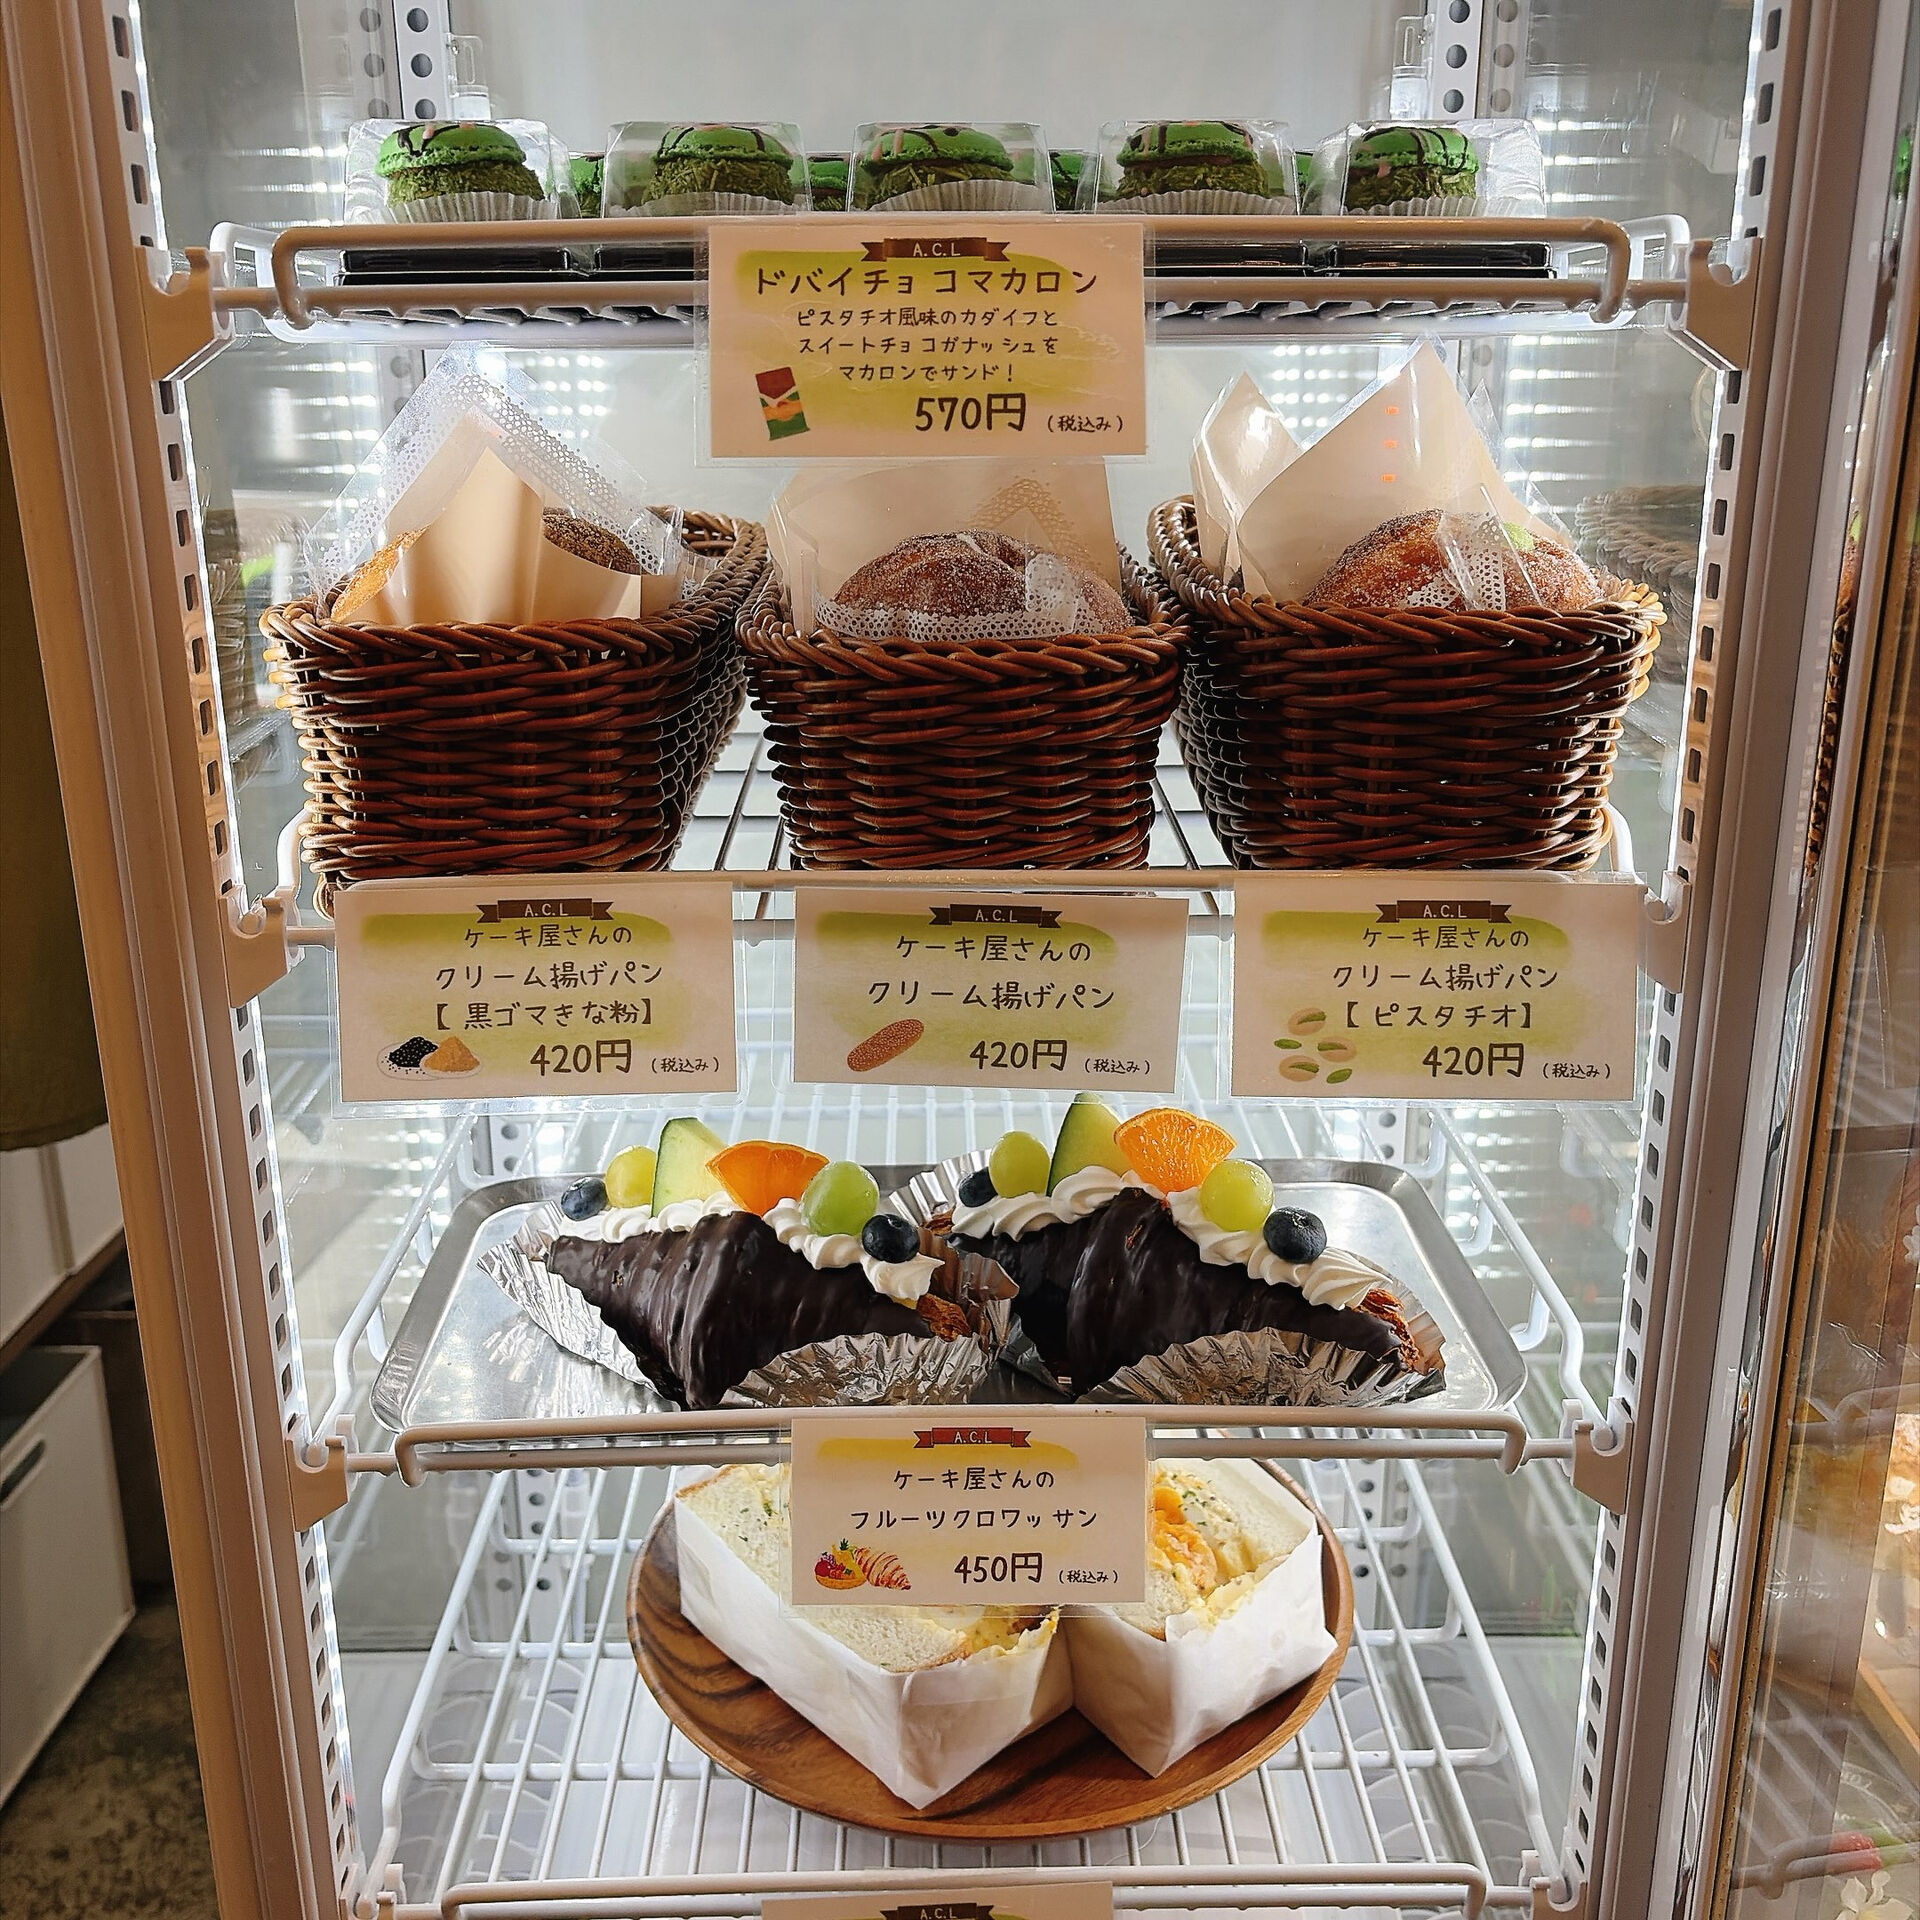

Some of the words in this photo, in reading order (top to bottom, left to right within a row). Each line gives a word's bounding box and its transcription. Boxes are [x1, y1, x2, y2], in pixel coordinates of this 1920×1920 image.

[913, 243, 961, 257] A.C.L
[756, 267, 1097, 296] ドバイチョコマカロン
[798, 307, 1058, 327] ピスタチオ風味のカダイフと
[799, 336, 1058, 354] スイートチョコガナッシュを
[915, 393, 1026, 432] 570円
[524, 904, 569, 917] A.C.L
[976, 909, 1018, 922] A.C.L
[1423, 904, 1468, 918] A.C.L
[465, 925, 632, 948] ケーキ屋さんの
[897, 935, 1091, 962] ケーキ屋さんの
[1362, 926, 1529, 949] ケーキ屋さんの
[435, 962, 663, 989] クリーム揚げパン
[1333, 964, 1558, 990] クリーム揚げパン
[868, 982, 1114, 1009] クリーム揚げパン
[437, 999, 652, 1030] 【黒ゴマきな粉】
[1347, 1002, 1531, 1028] 【ピスタチオ】
[530, 1039, 631, 1076] 420円
[970, 1039, 1067, 1070] 420円
[1422, 1043, 1525, 1078] 420円
[954, 1431, 992, 1444] A.C.L
[894, 1468, 1054, 1490] ケーキ屋さんの
[851, 1509, 1098, 1529] フルーツクロワッサン
[955, 1552, 1042, 1583] 450円
[920, 1908, 957, 1920] A.C.L
